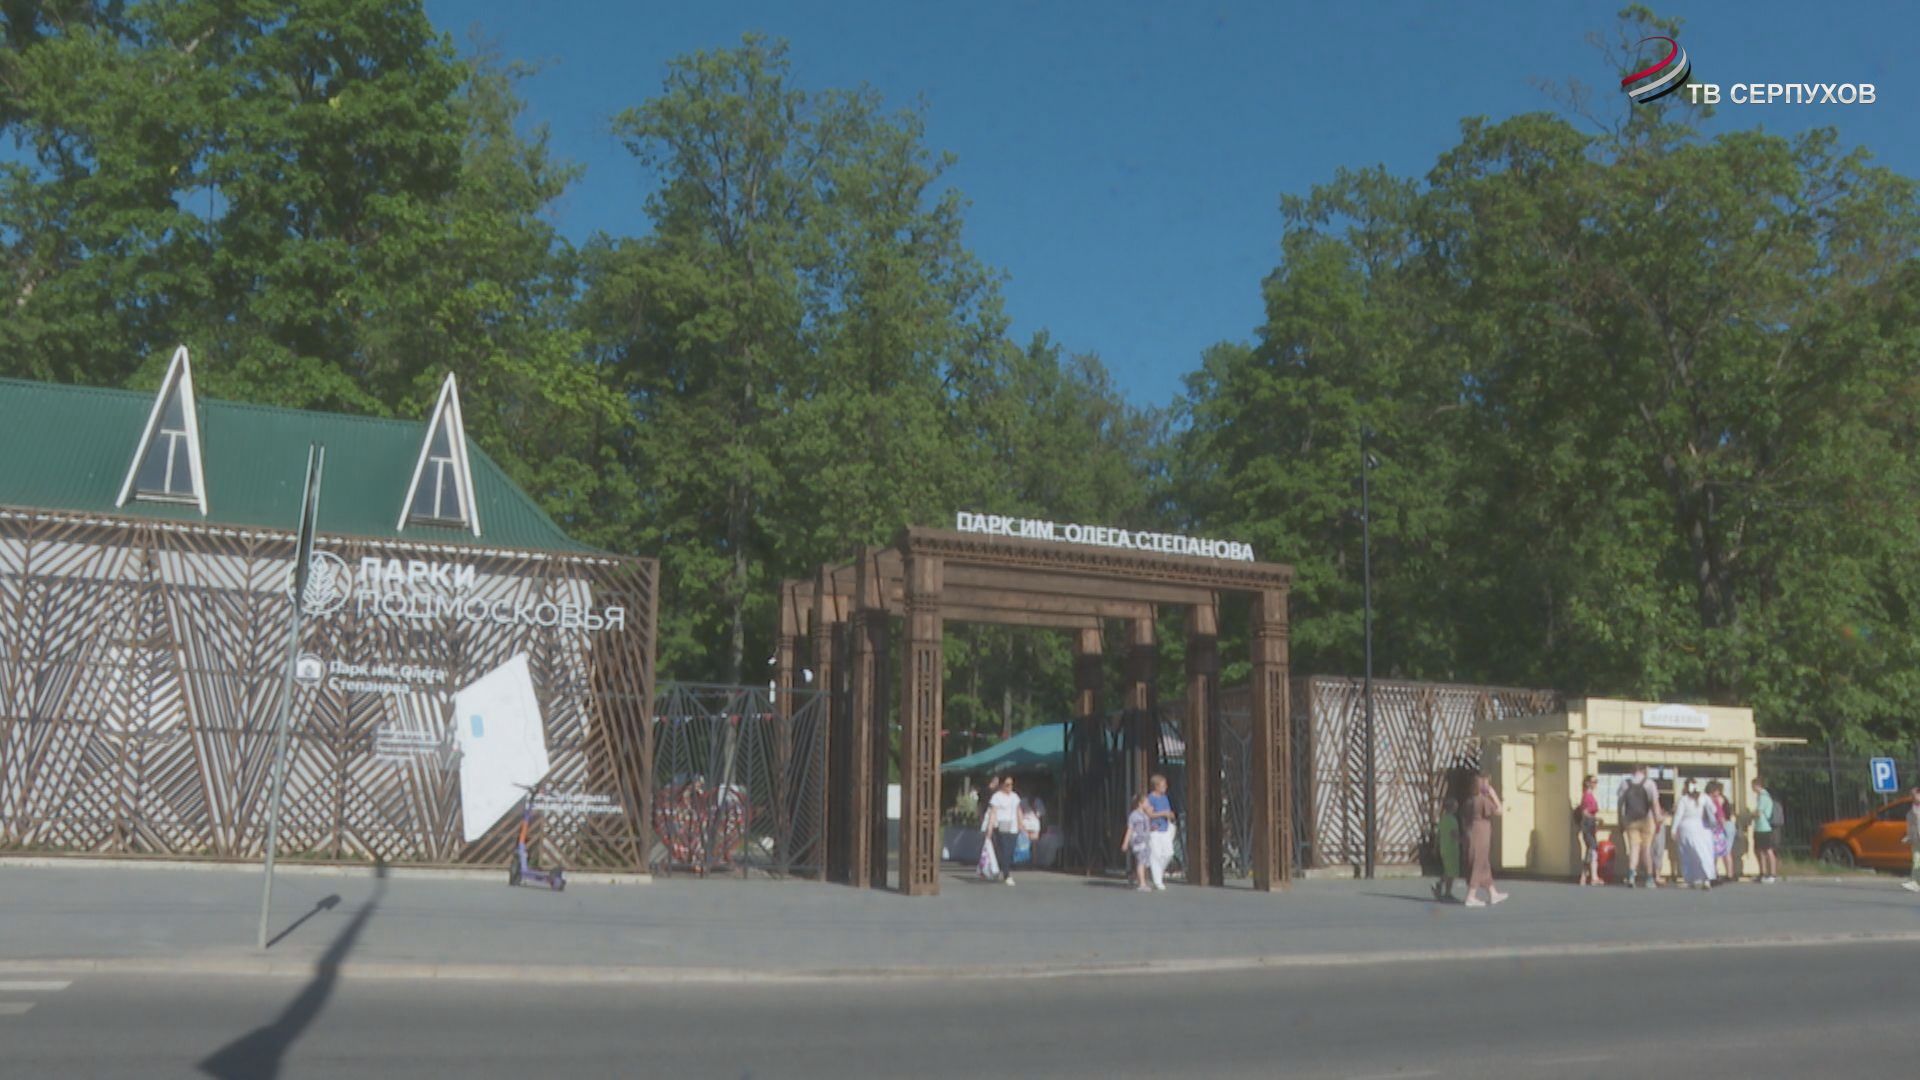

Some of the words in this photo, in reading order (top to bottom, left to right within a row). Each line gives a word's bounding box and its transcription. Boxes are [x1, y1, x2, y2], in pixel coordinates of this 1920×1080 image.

[957, 511, 1015, 536] ПАРК
[1065, 523, 1130, 548] ОЛЕГА
[1136, 531, 1255, 562] СТЕПАНОВА
[358, 556, 475, 588] ПАРКИ
[358, 589, 625, 632] ПОДМОСКОВЬЯ
[1876, 762, 1891, 789] P
